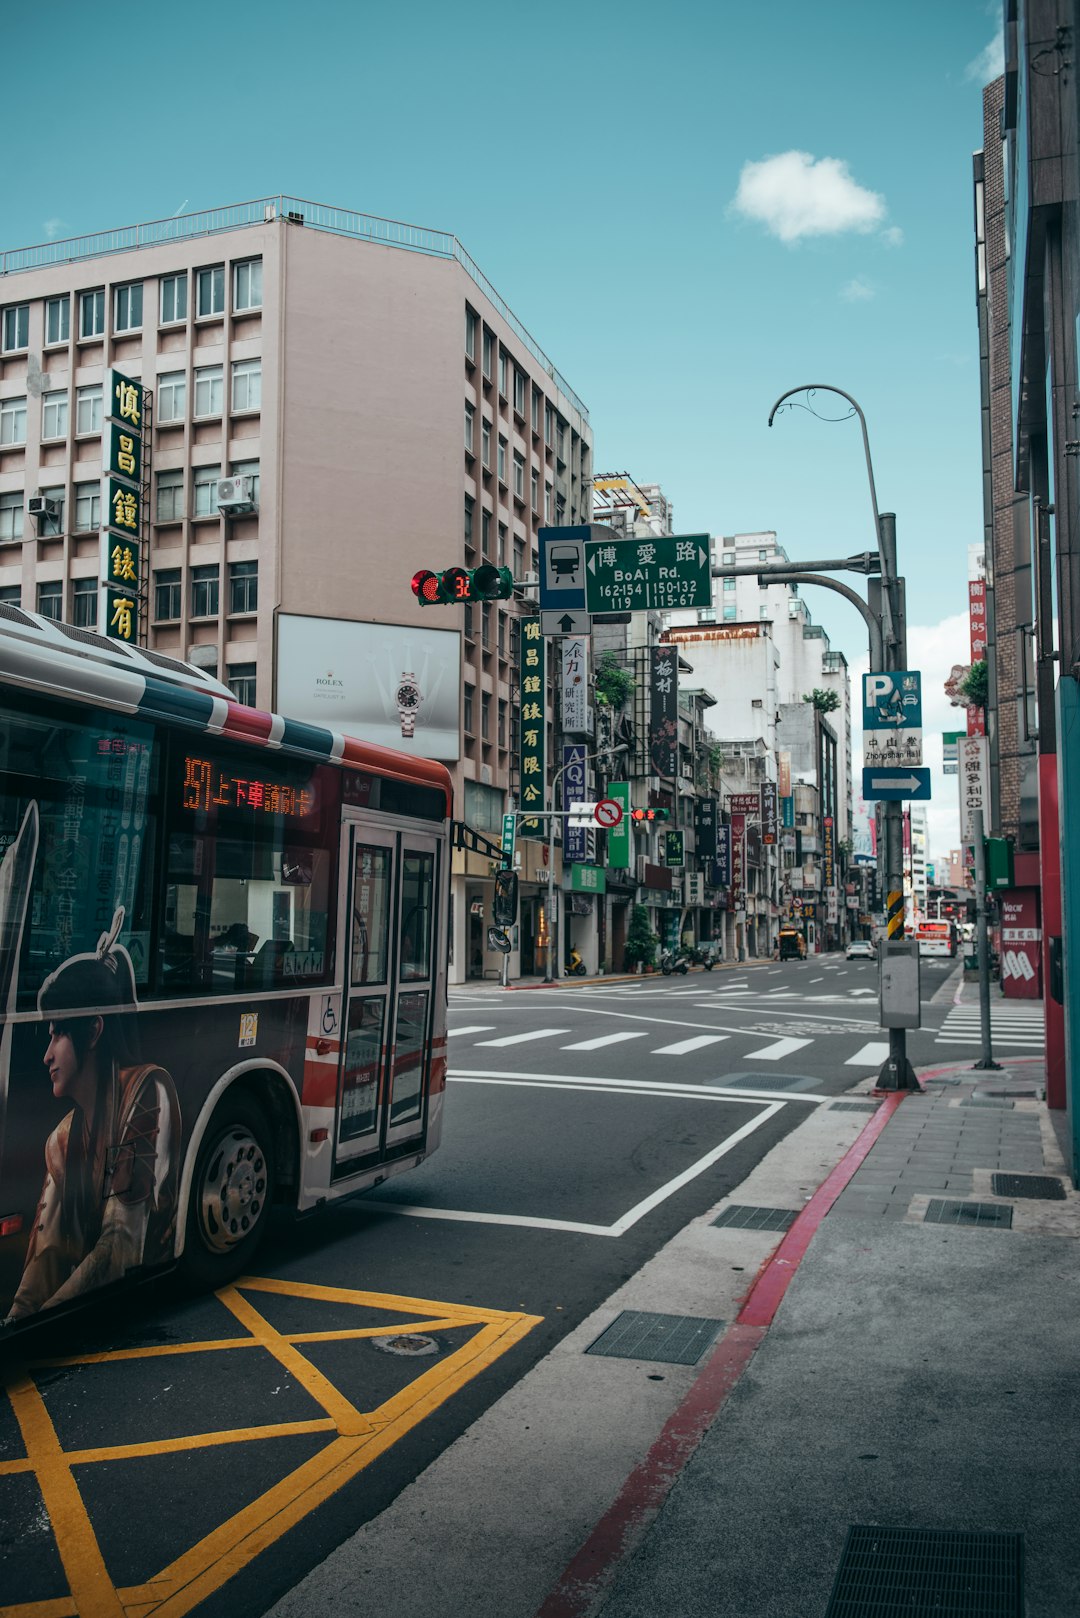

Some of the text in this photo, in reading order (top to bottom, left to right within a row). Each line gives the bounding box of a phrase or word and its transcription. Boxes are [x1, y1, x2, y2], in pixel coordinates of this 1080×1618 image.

[597, 541, 696, 567] 博愛路
[614, 566, 681, 582] BoAi Rd.
[600, 580, 697, 597] 162-154 150-132
[611, 593, 695, 609] 119 115-67
[970, 583, 985, 666] 衡陽85會
[316, 678, 344, 687] ROLEX
[866, 675, 894, 707] P
[869, 736, 918, 748] 中山堂
[866, 750, 921, 760] Zhongshan Hall
[535, 868, 556, 884] TUDR
